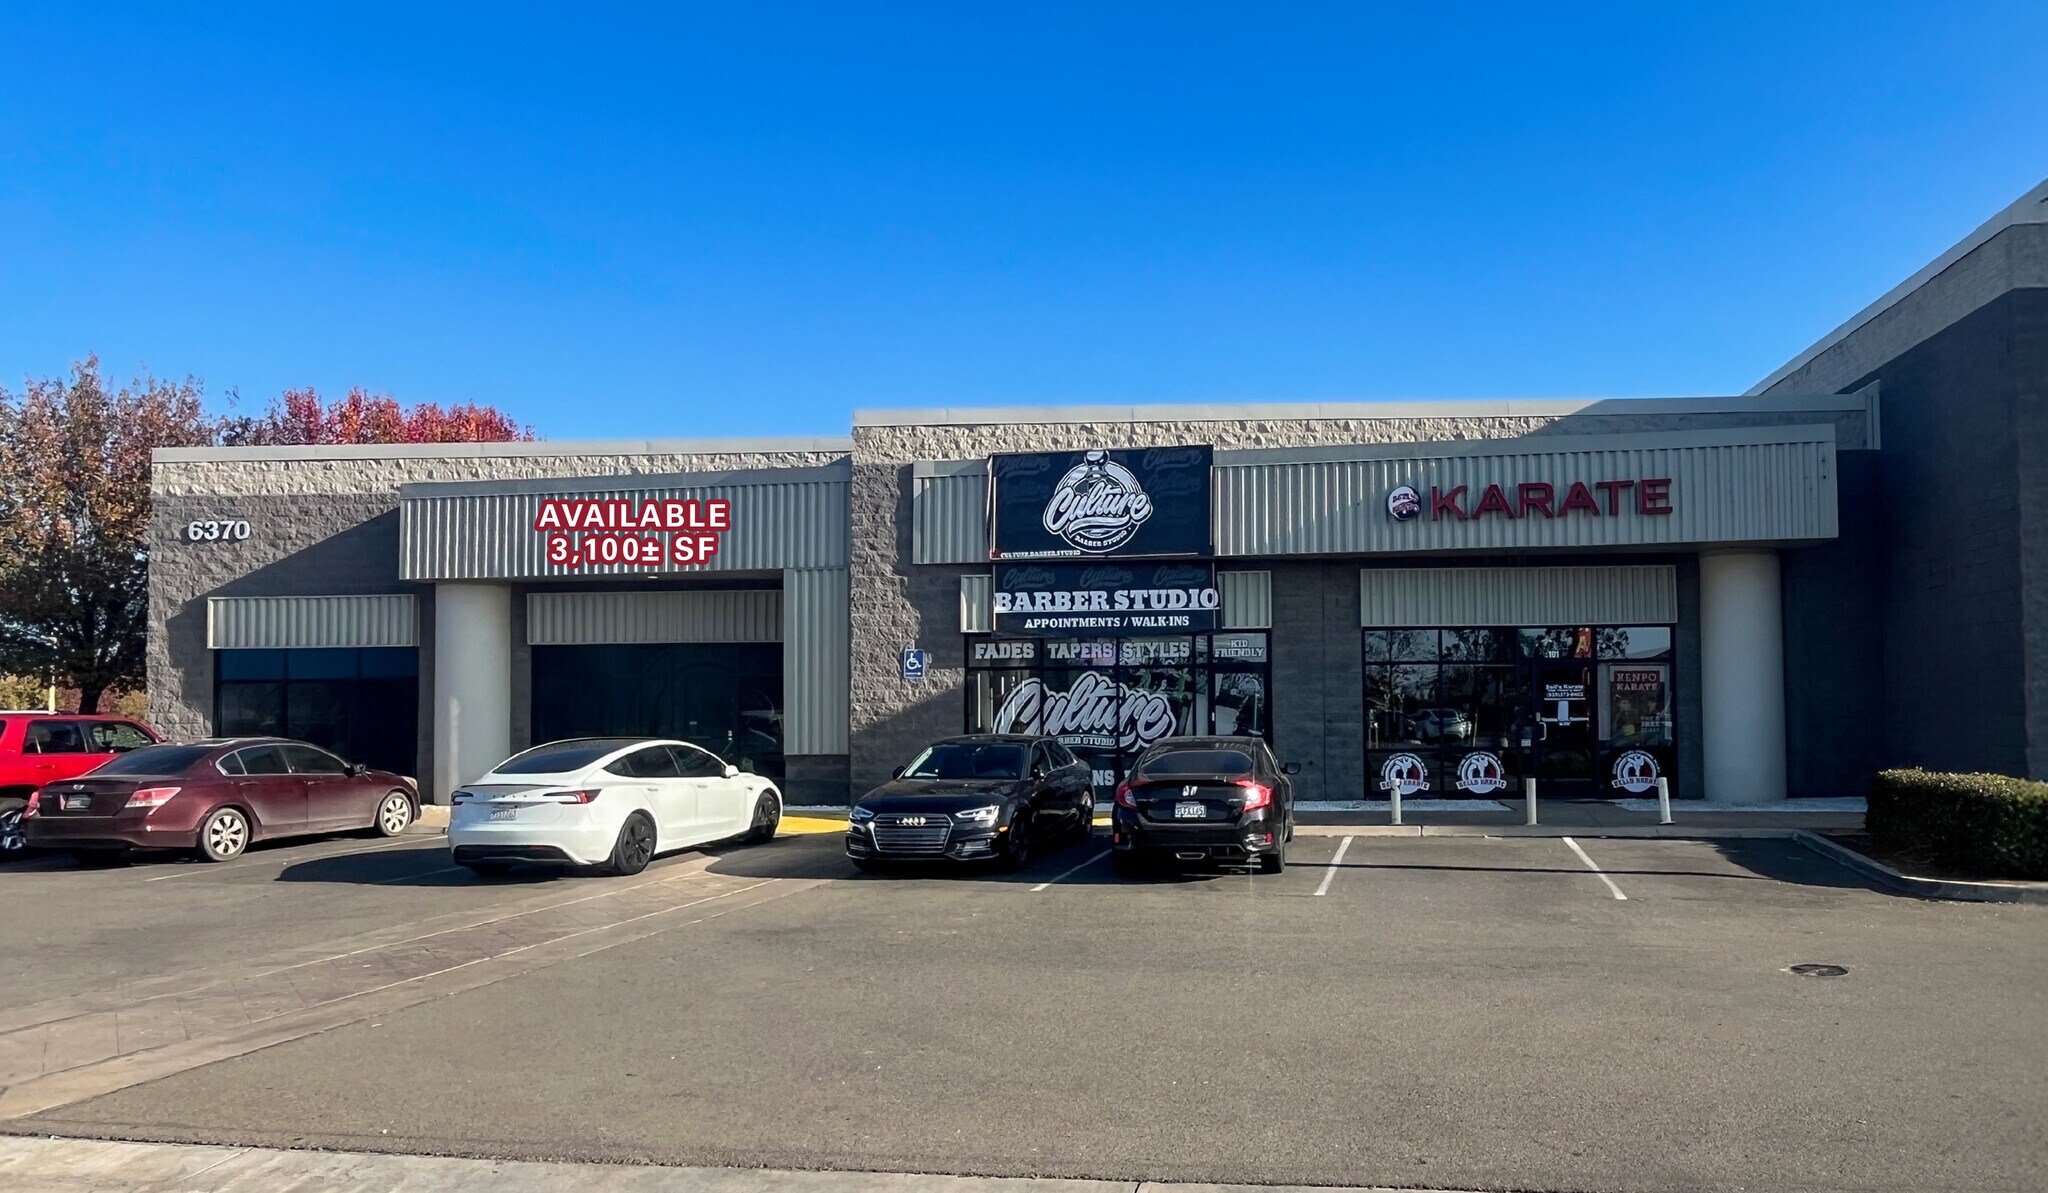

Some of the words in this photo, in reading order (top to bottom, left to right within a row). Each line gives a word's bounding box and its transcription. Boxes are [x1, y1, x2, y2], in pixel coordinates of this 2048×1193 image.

[1046, 480, 1152, 533] Culture
[1431, 478, 1674, 521] KARATE
[188, 520, 251, 540] 6370
[1074, 534, 1102, 547] BARBER
[1102, 530, 1128, 547] STUDIO
[995, 590, 1110, 612] BARBER
[1113, 588, 1219, 610] STUDIO
[1024, 616, 1121, 629] APPOINTMENTS
[1131, 616, 1190, 627] WALK-INS
[975, 642, 1035, 659] FADES
[1047, 642, 1114, 659] TAPERS
[1122, 641, 1190, 658] STYLES
[1230, 639, 1249, 648] KID
[1214, 648, 1264, 658] FRIENDLY
[1616, 672, 1657, 682] KENPO
[1616, 683, 1657, 691] KARATE
[998, 673, 1172, 740] Culture
[1083, 737, 1116, 746] STUDIO
